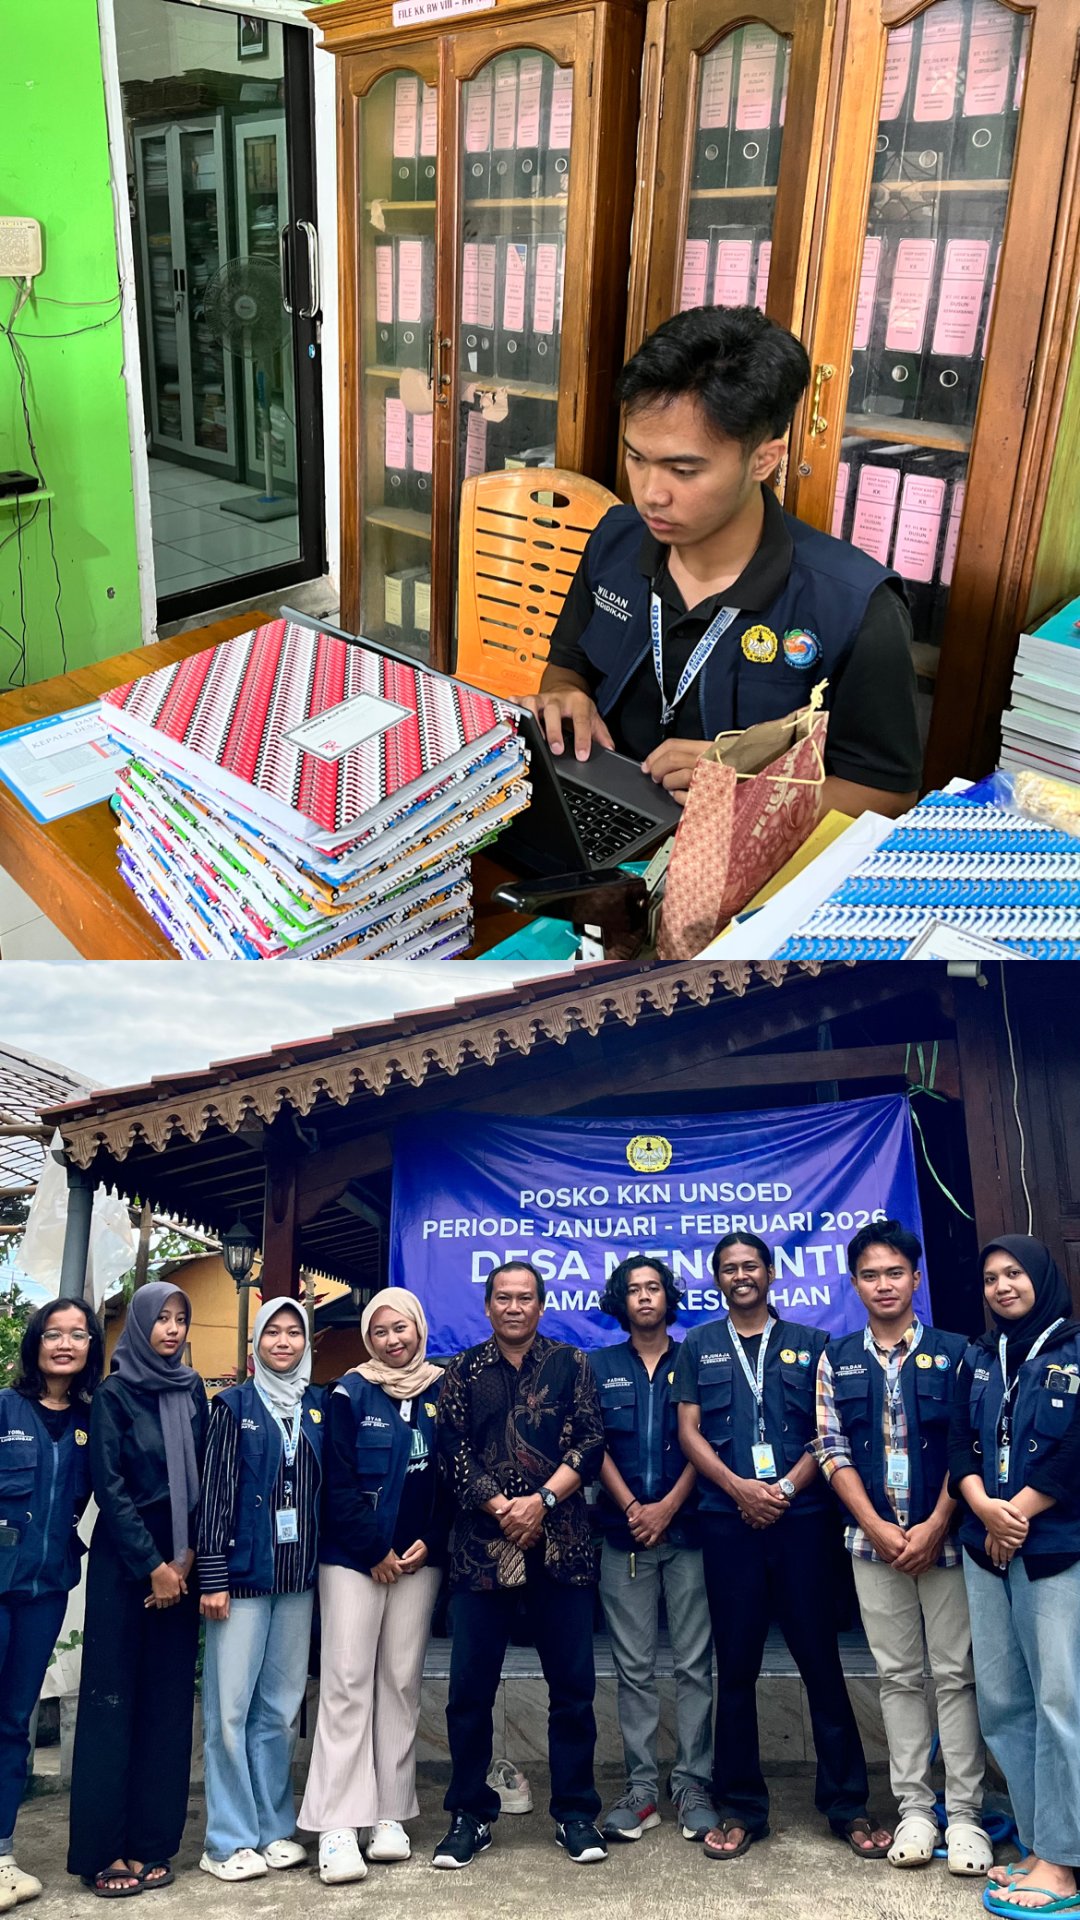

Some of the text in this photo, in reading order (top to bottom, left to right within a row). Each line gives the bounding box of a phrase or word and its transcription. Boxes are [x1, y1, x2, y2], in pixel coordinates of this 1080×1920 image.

[398, 8, 412, 19] FILE
[414, 5, 424, 16] KK
[427, 3, 438, 13] RW
[598, 585, 628, 608] WILDAN
[595, 598, 628, 621] NDIDIKAN
[652, 605, 661, 657] UNSOED
[32, 731, 73, 749] KEPALA
[74, 721, 101, 734] DESA
[520, 1183, 792, 1208] POSKO KKN UNSOED
[422, 1218, 534, 1239] PERIODE
[541, 1216, 657, 1237] JANUARI
[681, 1211, 813, 1234] FEBRUARI
[821, 1208, 888, 1231] 2026
[604, 1244, 847, 1280] MNNTI
[678, 1285, 831, 1310] ESHAN
